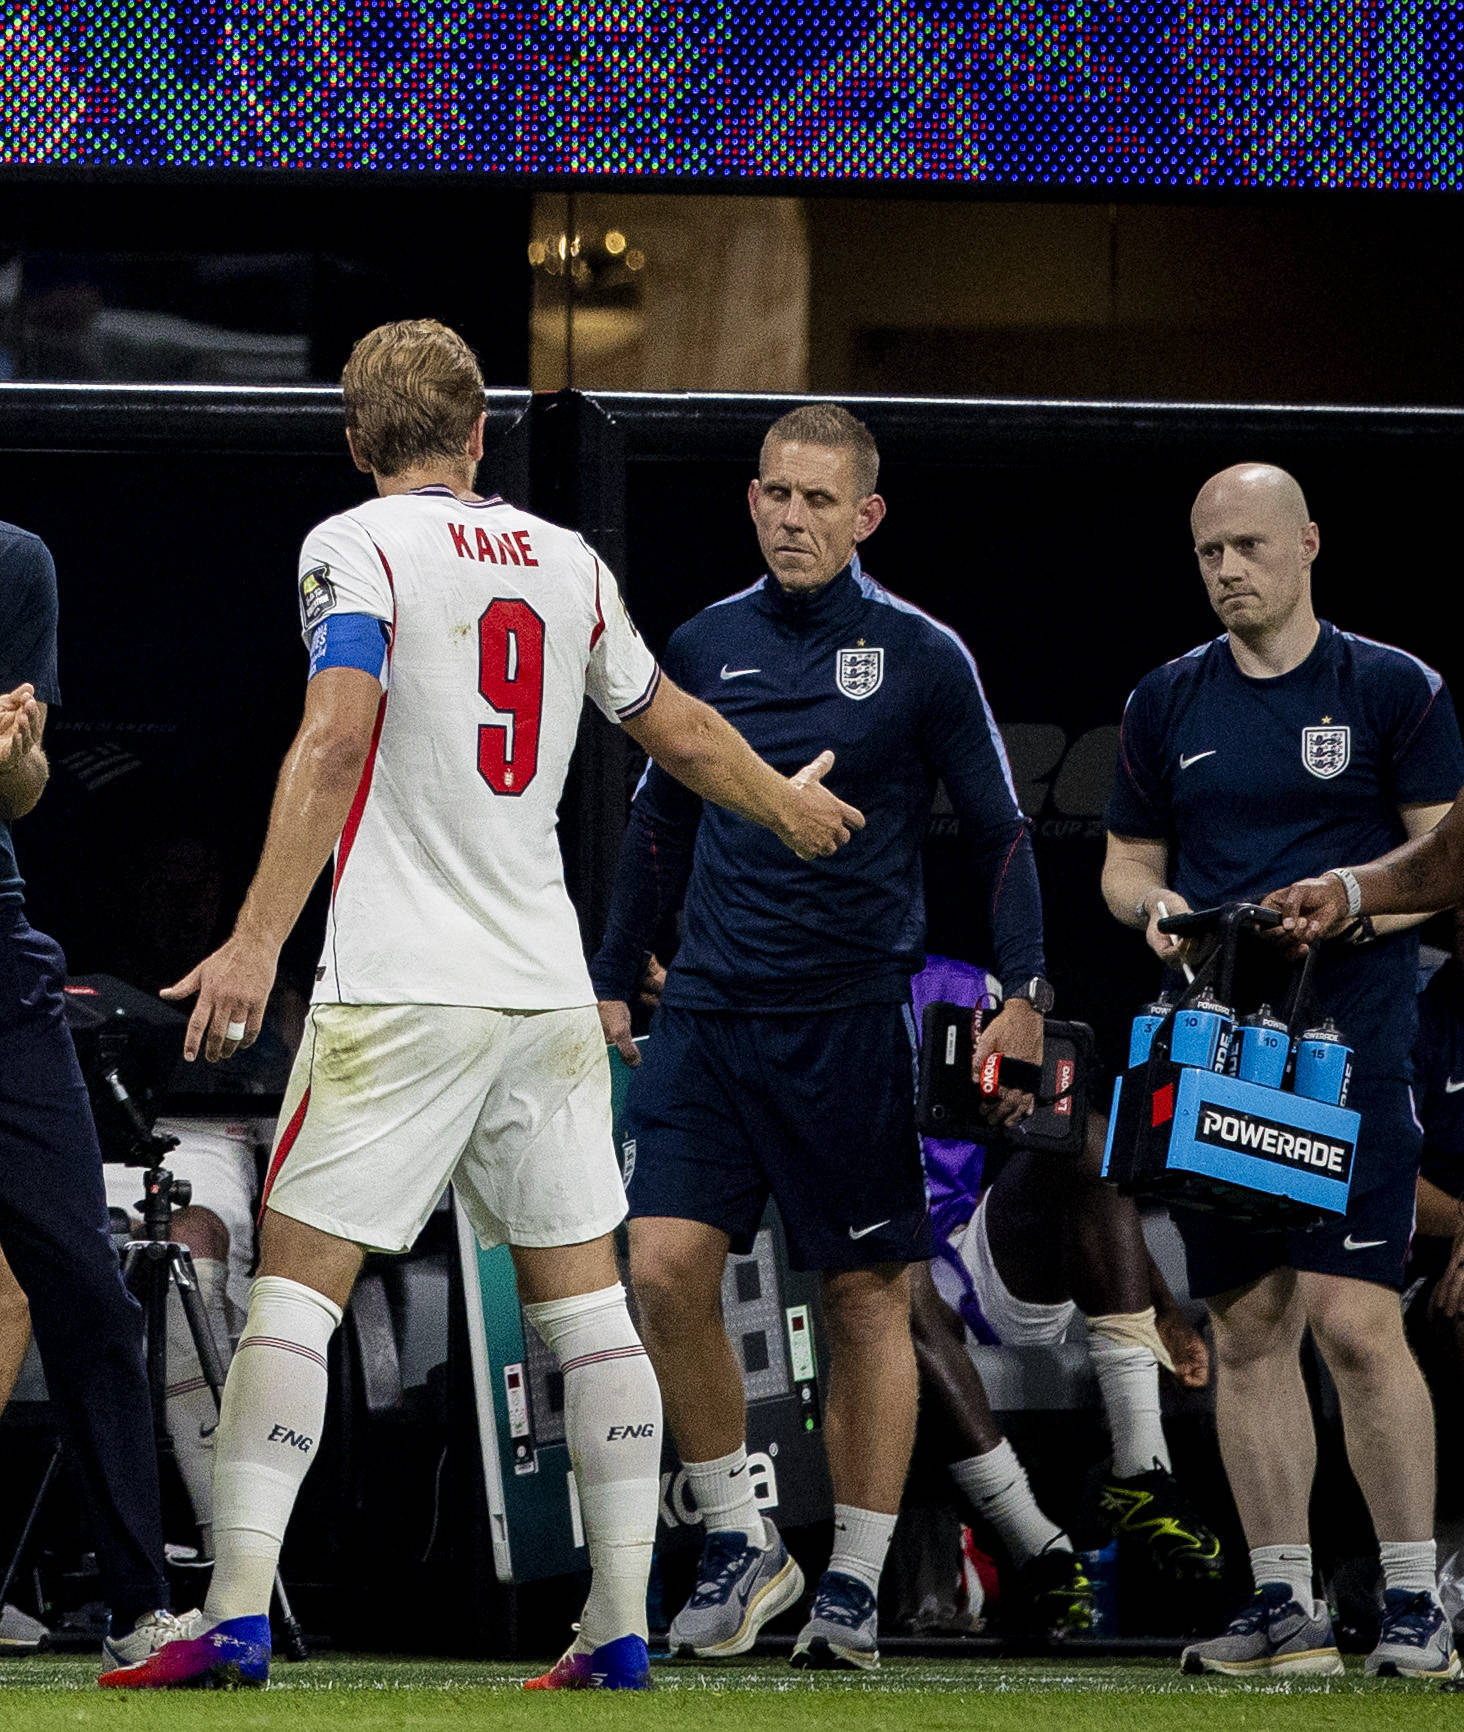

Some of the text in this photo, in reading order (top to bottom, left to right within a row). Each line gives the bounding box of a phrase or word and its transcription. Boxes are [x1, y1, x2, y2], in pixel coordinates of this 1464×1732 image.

[447, 523, 539, 567] KANE
[477, 597, 545, 796] 9
[1144, 1024, 1152, 1033] 3
[1184, 1018, 1198, 1027] 10
[1265, 1037, 1278, 1048] 10
[1311, 1049, 1325, 1059] 15
[1057, 1065, 1072, 1111] Leovo
[1203, 1110, 1345, 1173] POWERADE
[267, 1424, 313, 1453] ENG
[607, 1423, 654, 1441] ENG
